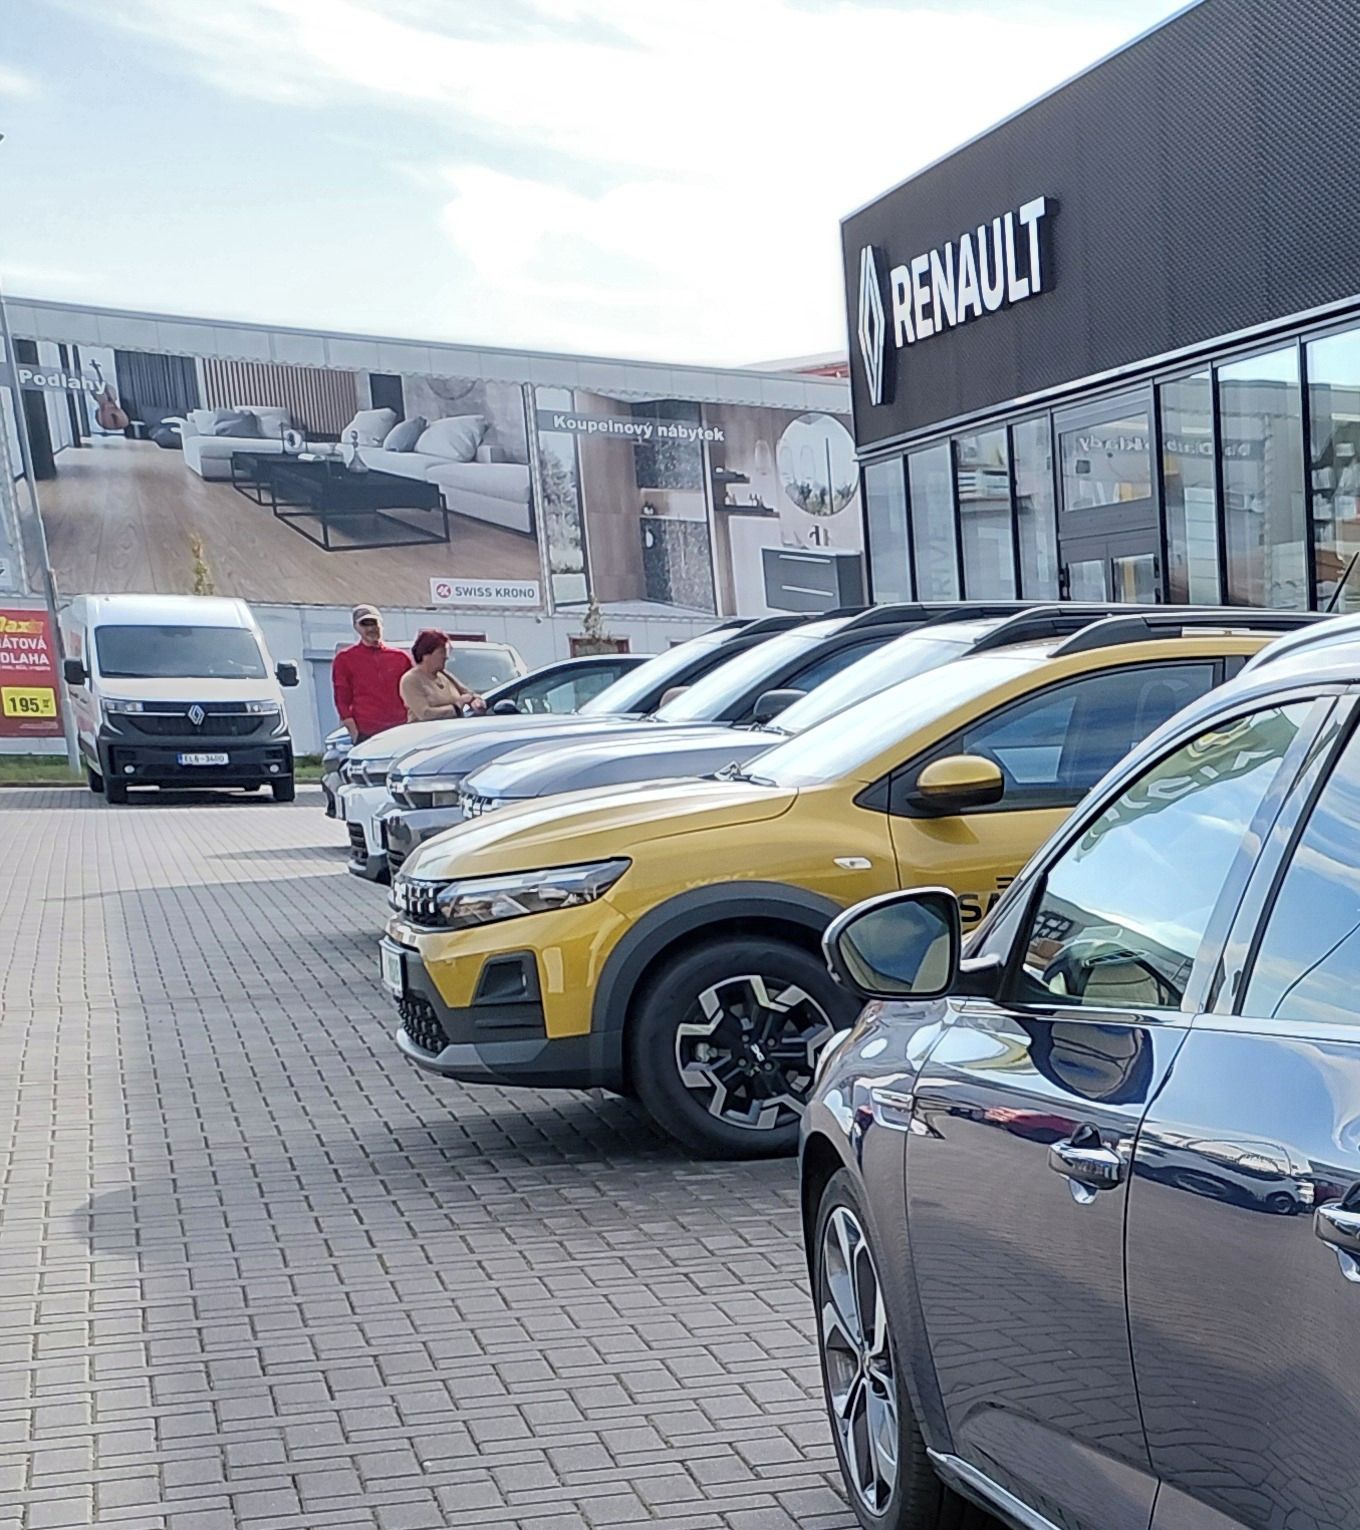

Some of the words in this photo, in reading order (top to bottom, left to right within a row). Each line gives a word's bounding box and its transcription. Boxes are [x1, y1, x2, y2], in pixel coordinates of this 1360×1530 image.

[889, 195, 1046, 349] RENAULT
[18, 369, 107, 395] Podlahy
[553, 415, 653, 438] Koupelnový
[658, 424, 725, 442] nábytek
[455, 586, 492, 598] SWISS
[495, 587, 535, 599] KRONO
[0, 634, 48, 650] ÁTOVÁ
